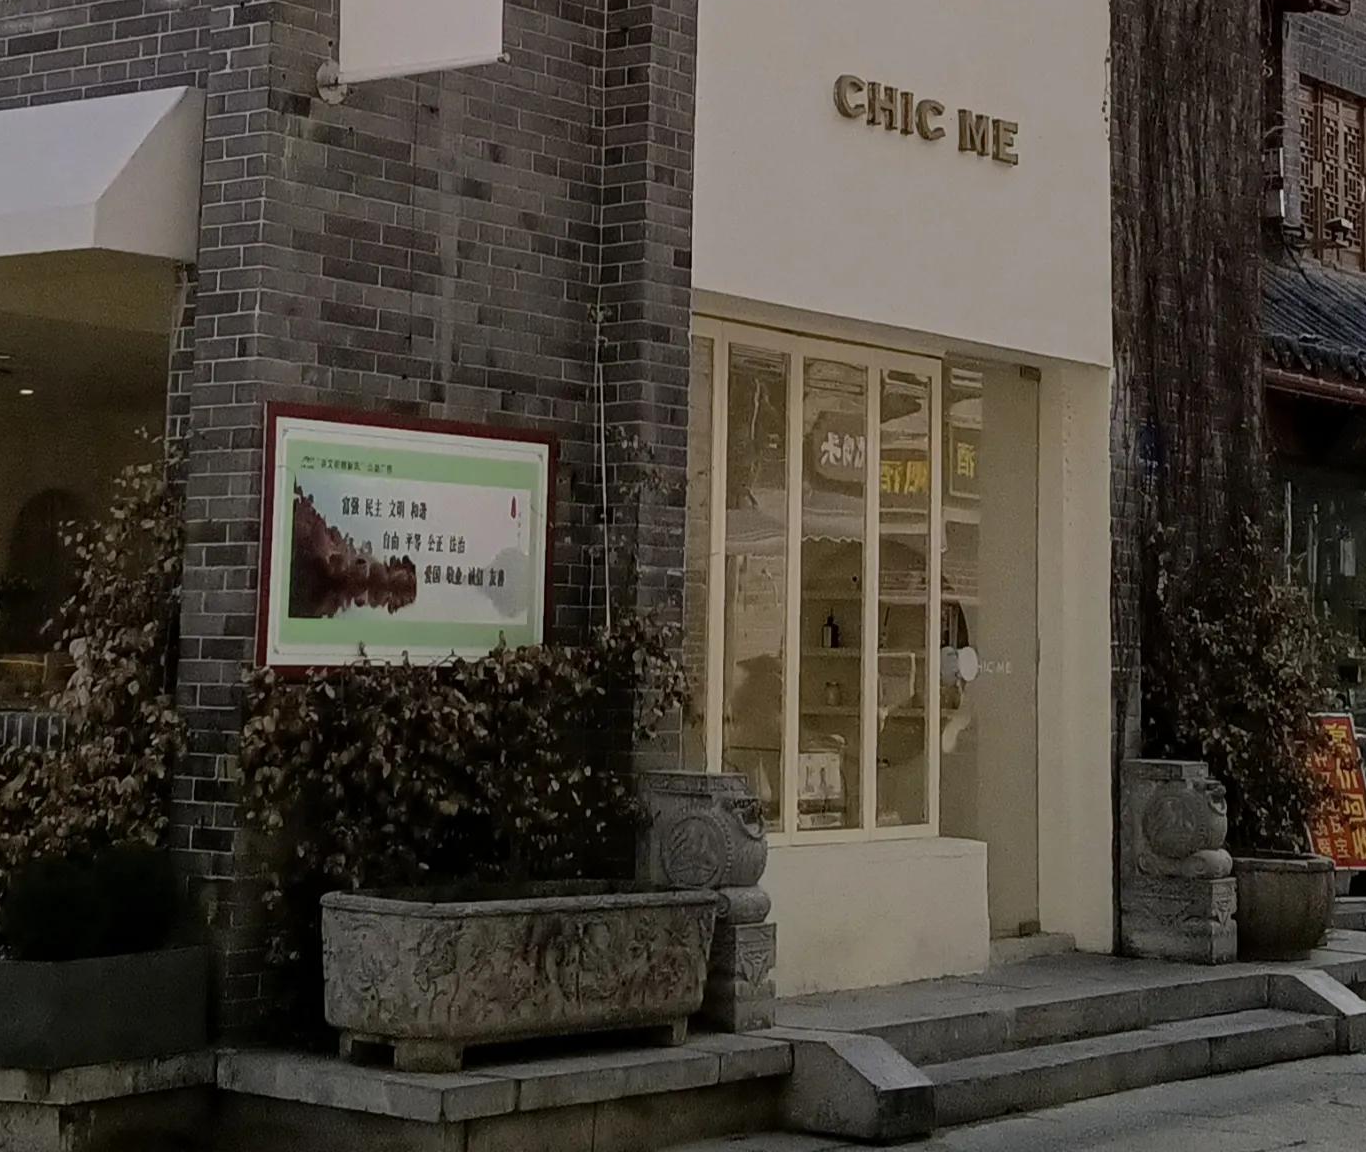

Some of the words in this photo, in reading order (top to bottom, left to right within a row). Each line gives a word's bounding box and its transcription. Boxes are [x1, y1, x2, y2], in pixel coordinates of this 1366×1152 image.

[833, 74, 946, 141] CHIC
[957, 108, 1019, 166] ME
[342, 497, 360, 515] 富强
[365, 499, 382, 518] 民主
[388, 500, 405, 519] 文明
[411, 501, 428, 520] 和谐
[383, 531, 400, 551] 自由
[405, 533, 422, 552] 平等
[428, 534, 444, 553] 公正
[449, 536, 466, 554] 法治
[424, 564, 441, 585] 爱国
[446, 566, 463, 585] 敬业
[467, 567, 484, 586] 诚信
[488, 568, 505, 587] 友善
